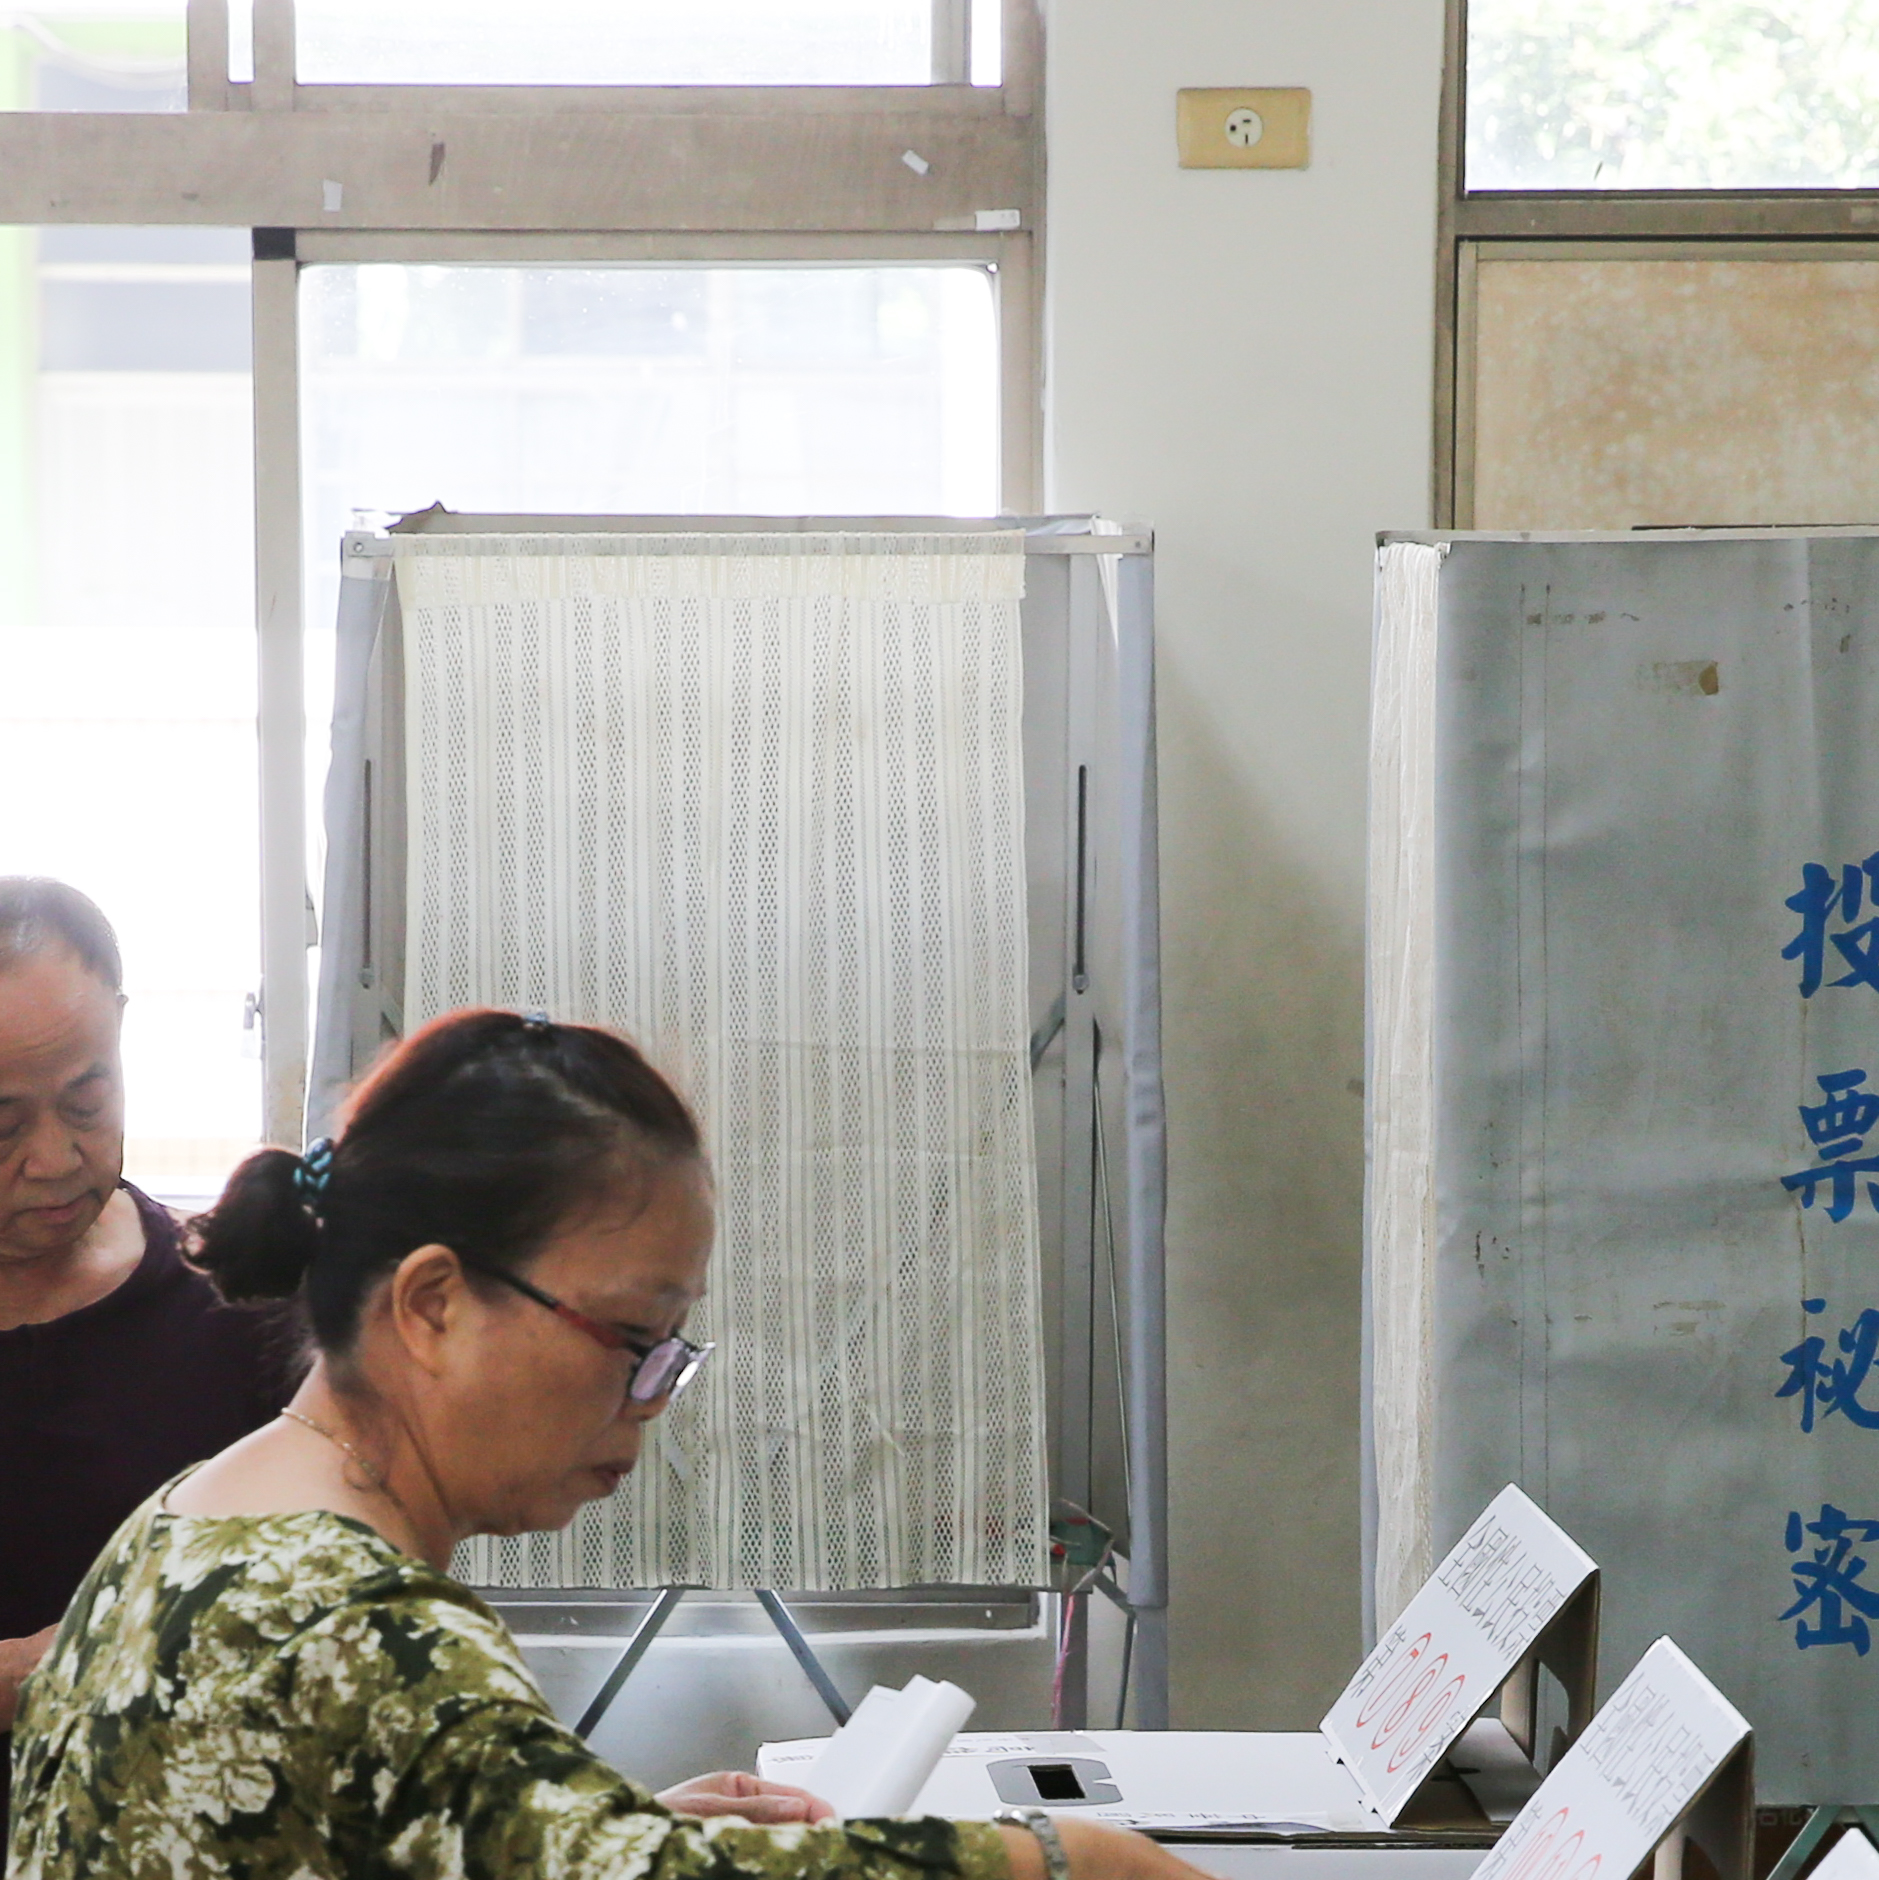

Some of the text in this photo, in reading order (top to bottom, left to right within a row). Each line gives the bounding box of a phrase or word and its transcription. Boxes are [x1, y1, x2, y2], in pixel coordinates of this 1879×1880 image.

[1437, 1514, 1566, 1664] 全國性公民投票
